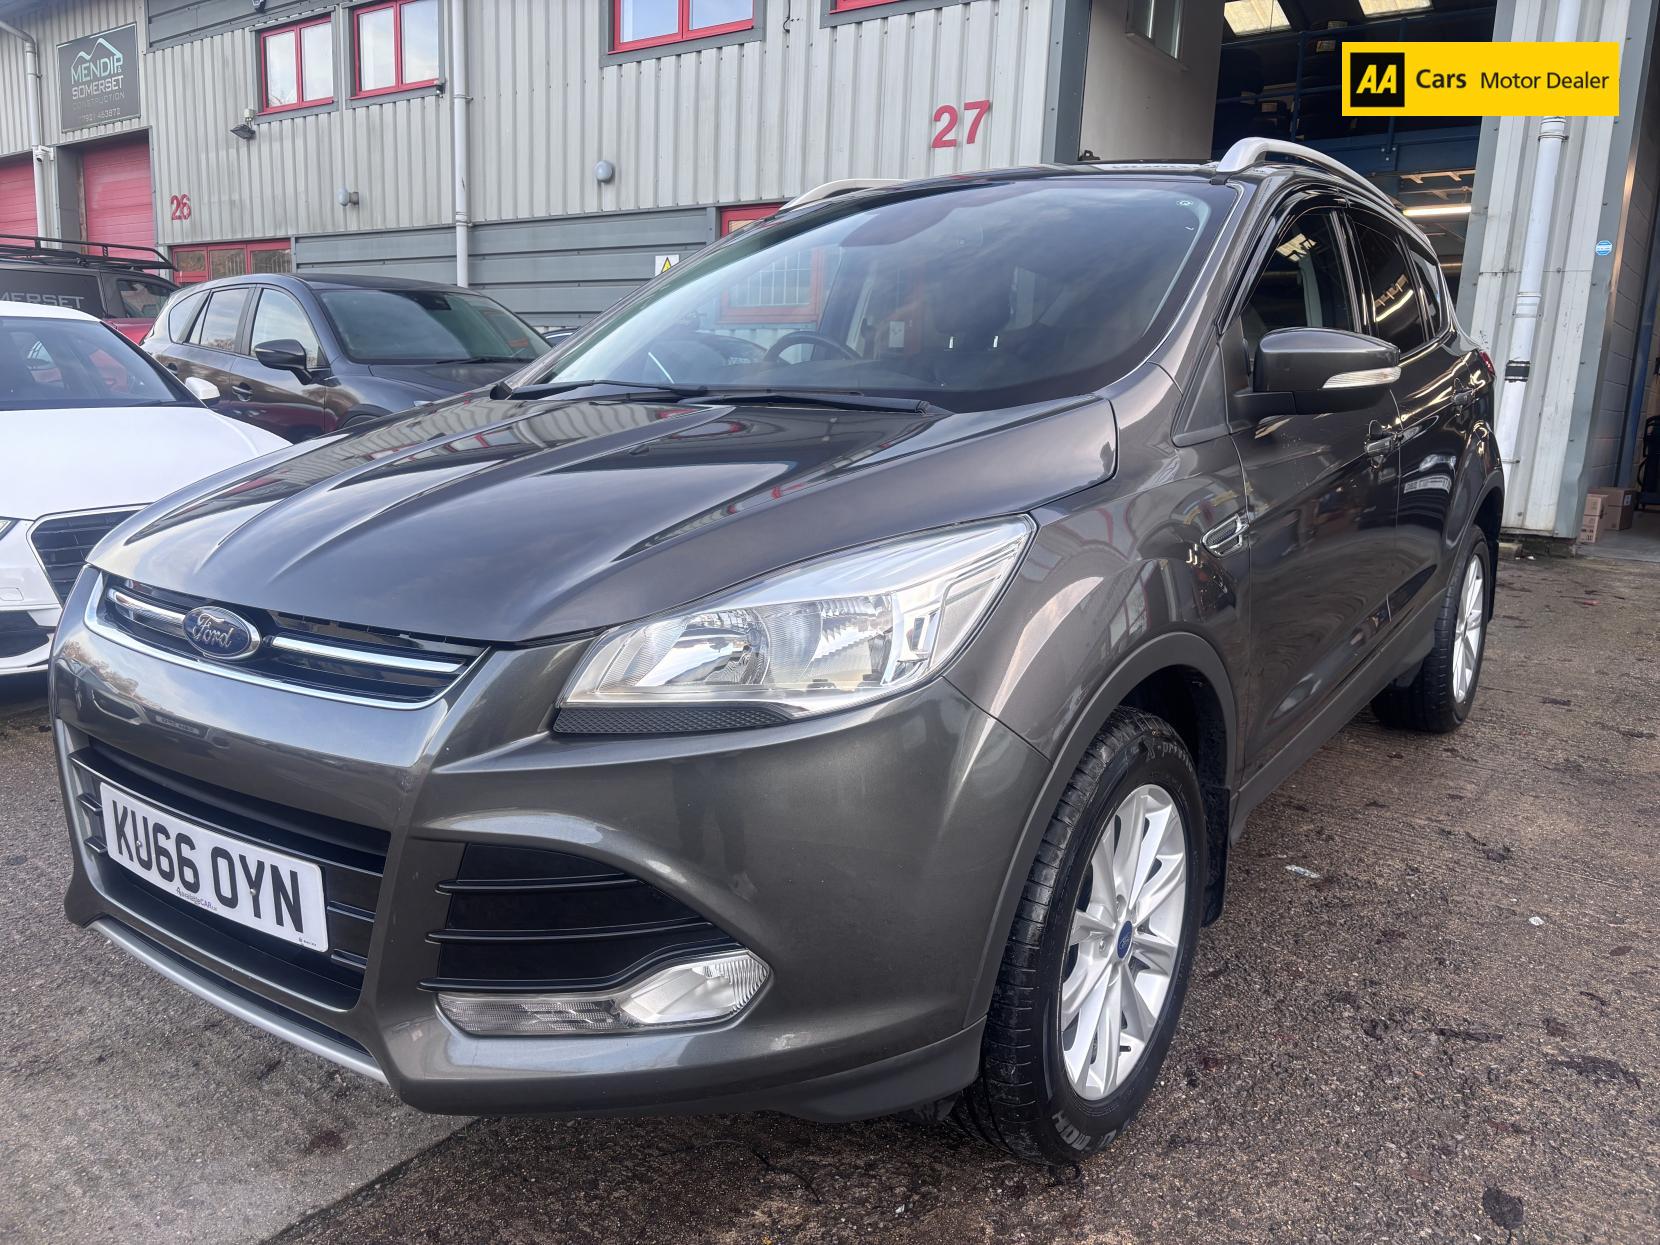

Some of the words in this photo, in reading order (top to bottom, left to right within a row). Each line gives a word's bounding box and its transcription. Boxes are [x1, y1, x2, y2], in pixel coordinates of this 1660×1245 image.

[71, 54, 123, 85] MENDIP
[72, 75, 124, 100] SOMERSET
[931, 99, 991, 149] 27
[170, 193, 191, 221] 26
[192, 612, 235, 648] Ford
[112, 799, 201, 894] KU66
[210, 845, 304, 934] OYN
